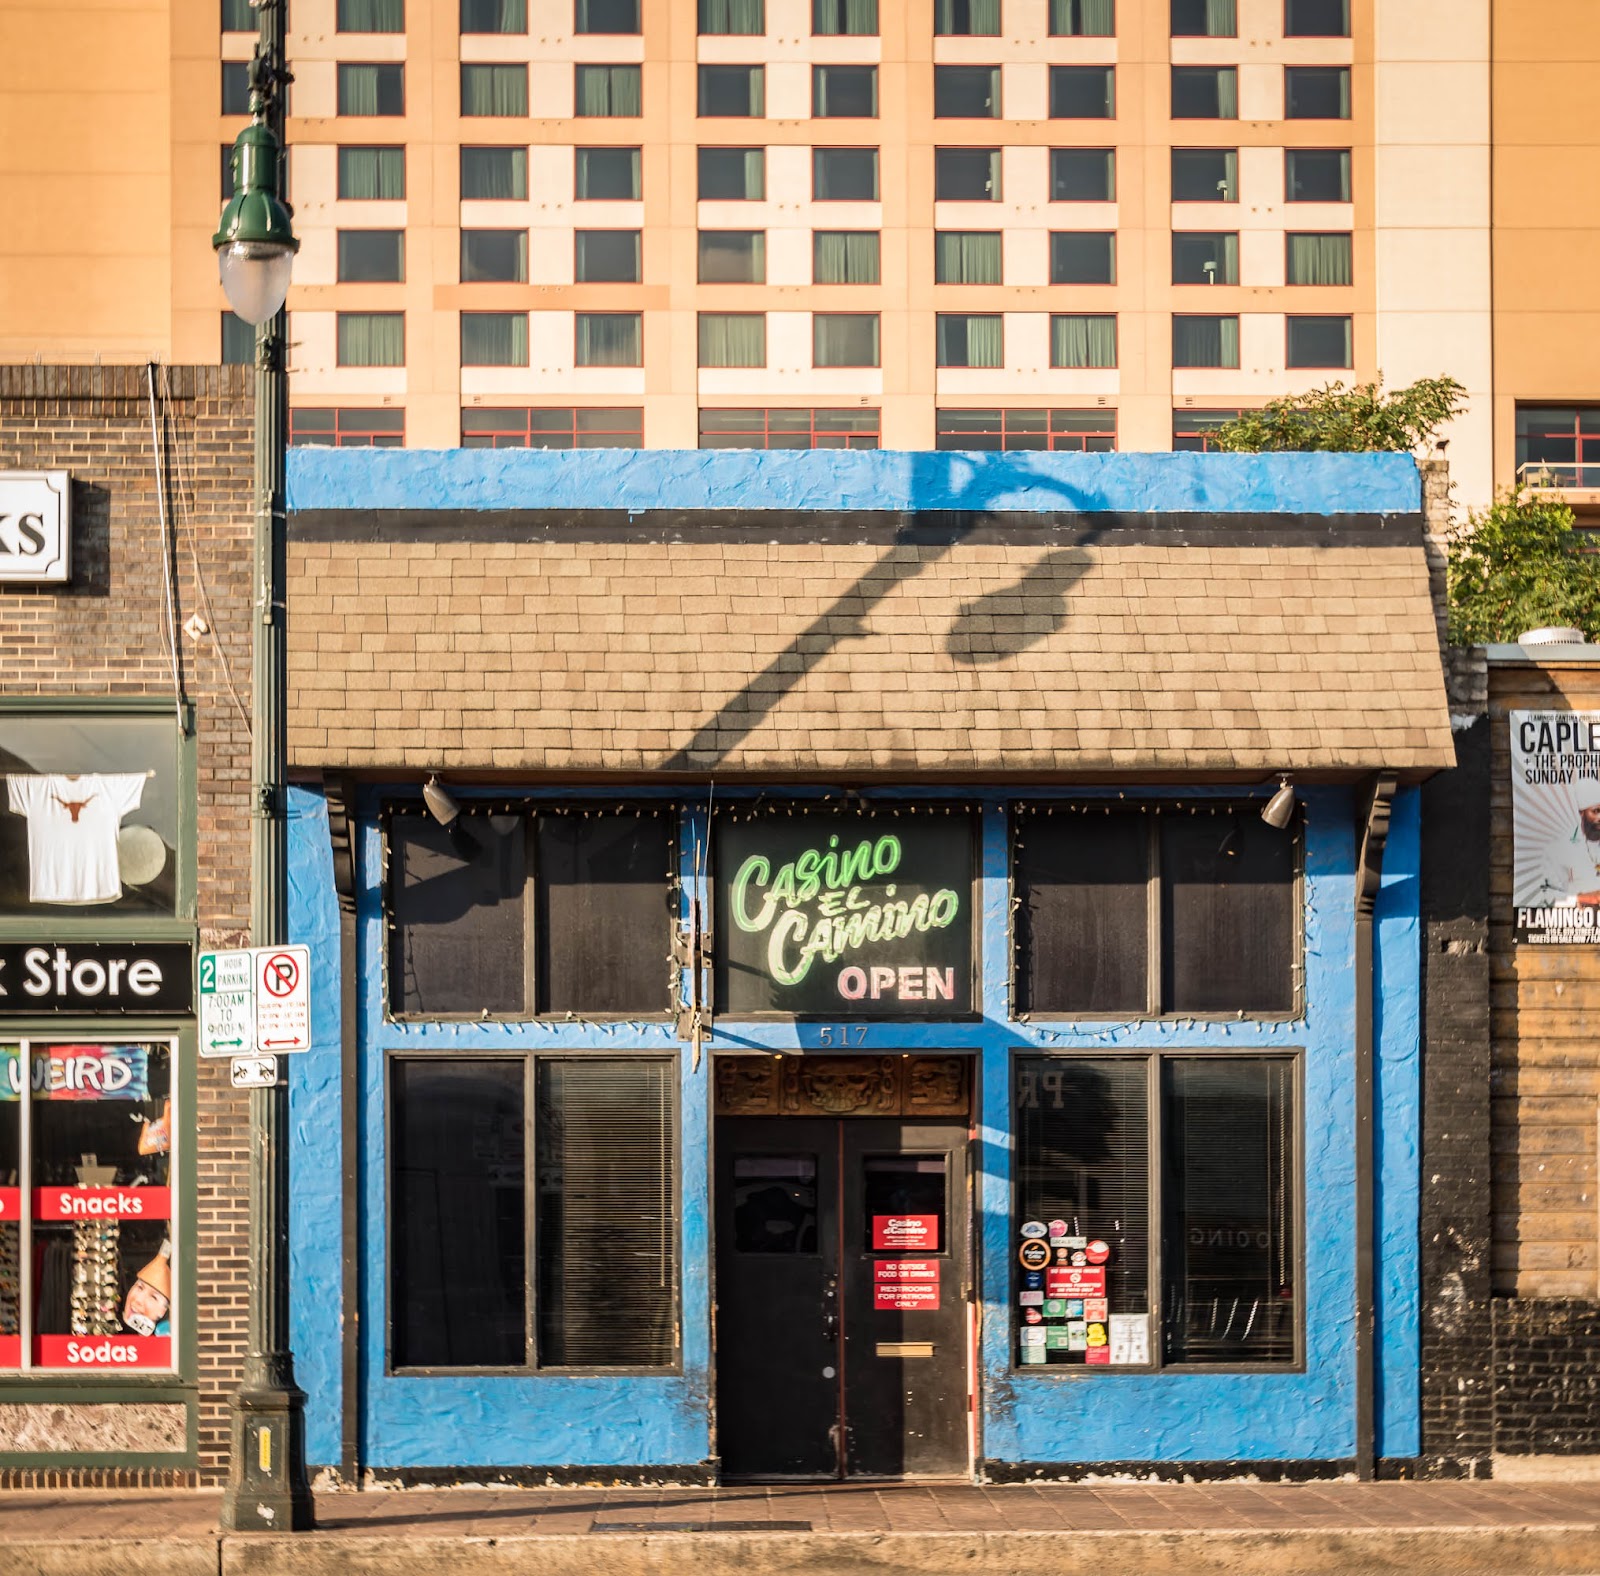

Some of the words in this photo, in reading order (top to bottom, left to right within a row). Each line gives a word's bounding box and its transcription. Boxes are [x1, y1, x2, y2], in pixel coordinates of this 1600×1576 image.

[1520, 722, 1600, 753] CAPLE
[1534, 754, 1556, 769] THE
[1560, 754, 1600, 769] PROPH
[1525, 769, 1574, 785] SUNDAY
[1517, 907, 1594, 928] FLAMINGO
[23, 947, 163, 996] Store
[201, 959, 214, 988] 2
[224, 958, 242, 969] HOUR
[217, 973, 248, 986] PARKING
[837, 966, 955, 1000] OPEN
[208, 994, 244, 1008] 7:00AM
[220, 1009, 233, 1022] TO
[819, 1026, 868, 1047] 517
[59, 1192, 143, 1215] Snacks
[880, 1285, 933, 1293] RESTROOMS
[67, 1341, 138, 1363] Sodas
